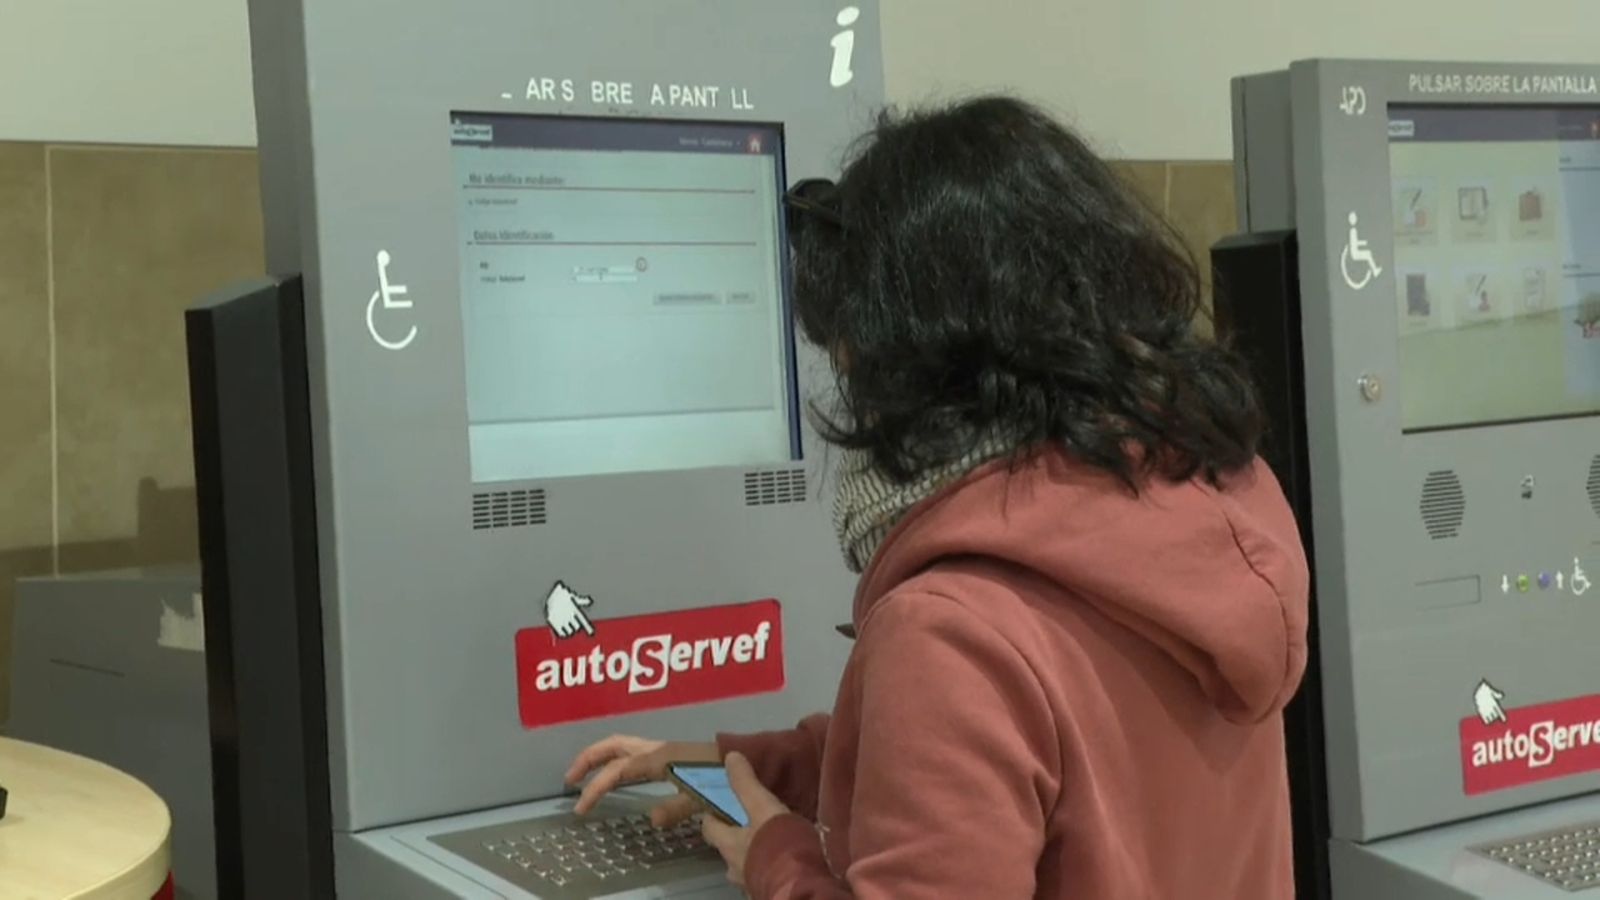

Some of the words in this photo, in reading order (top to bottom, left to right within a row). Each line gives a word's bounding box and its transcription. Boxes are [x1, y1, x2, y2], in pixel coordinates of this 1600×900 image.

[591, 80, 633, 105] BRE
[669, 84, 719, 108] PANT
[731, 87, 754, 110] LL
[1409, 73, 1462, 93] PULSAR
[1465, 74, 1510, 93] SOBRE
[1512, 76, 1531, 94] LA
[1533, 75, 1598, 95] PANTALLA
[535, 620, 771, 693] autoServef
